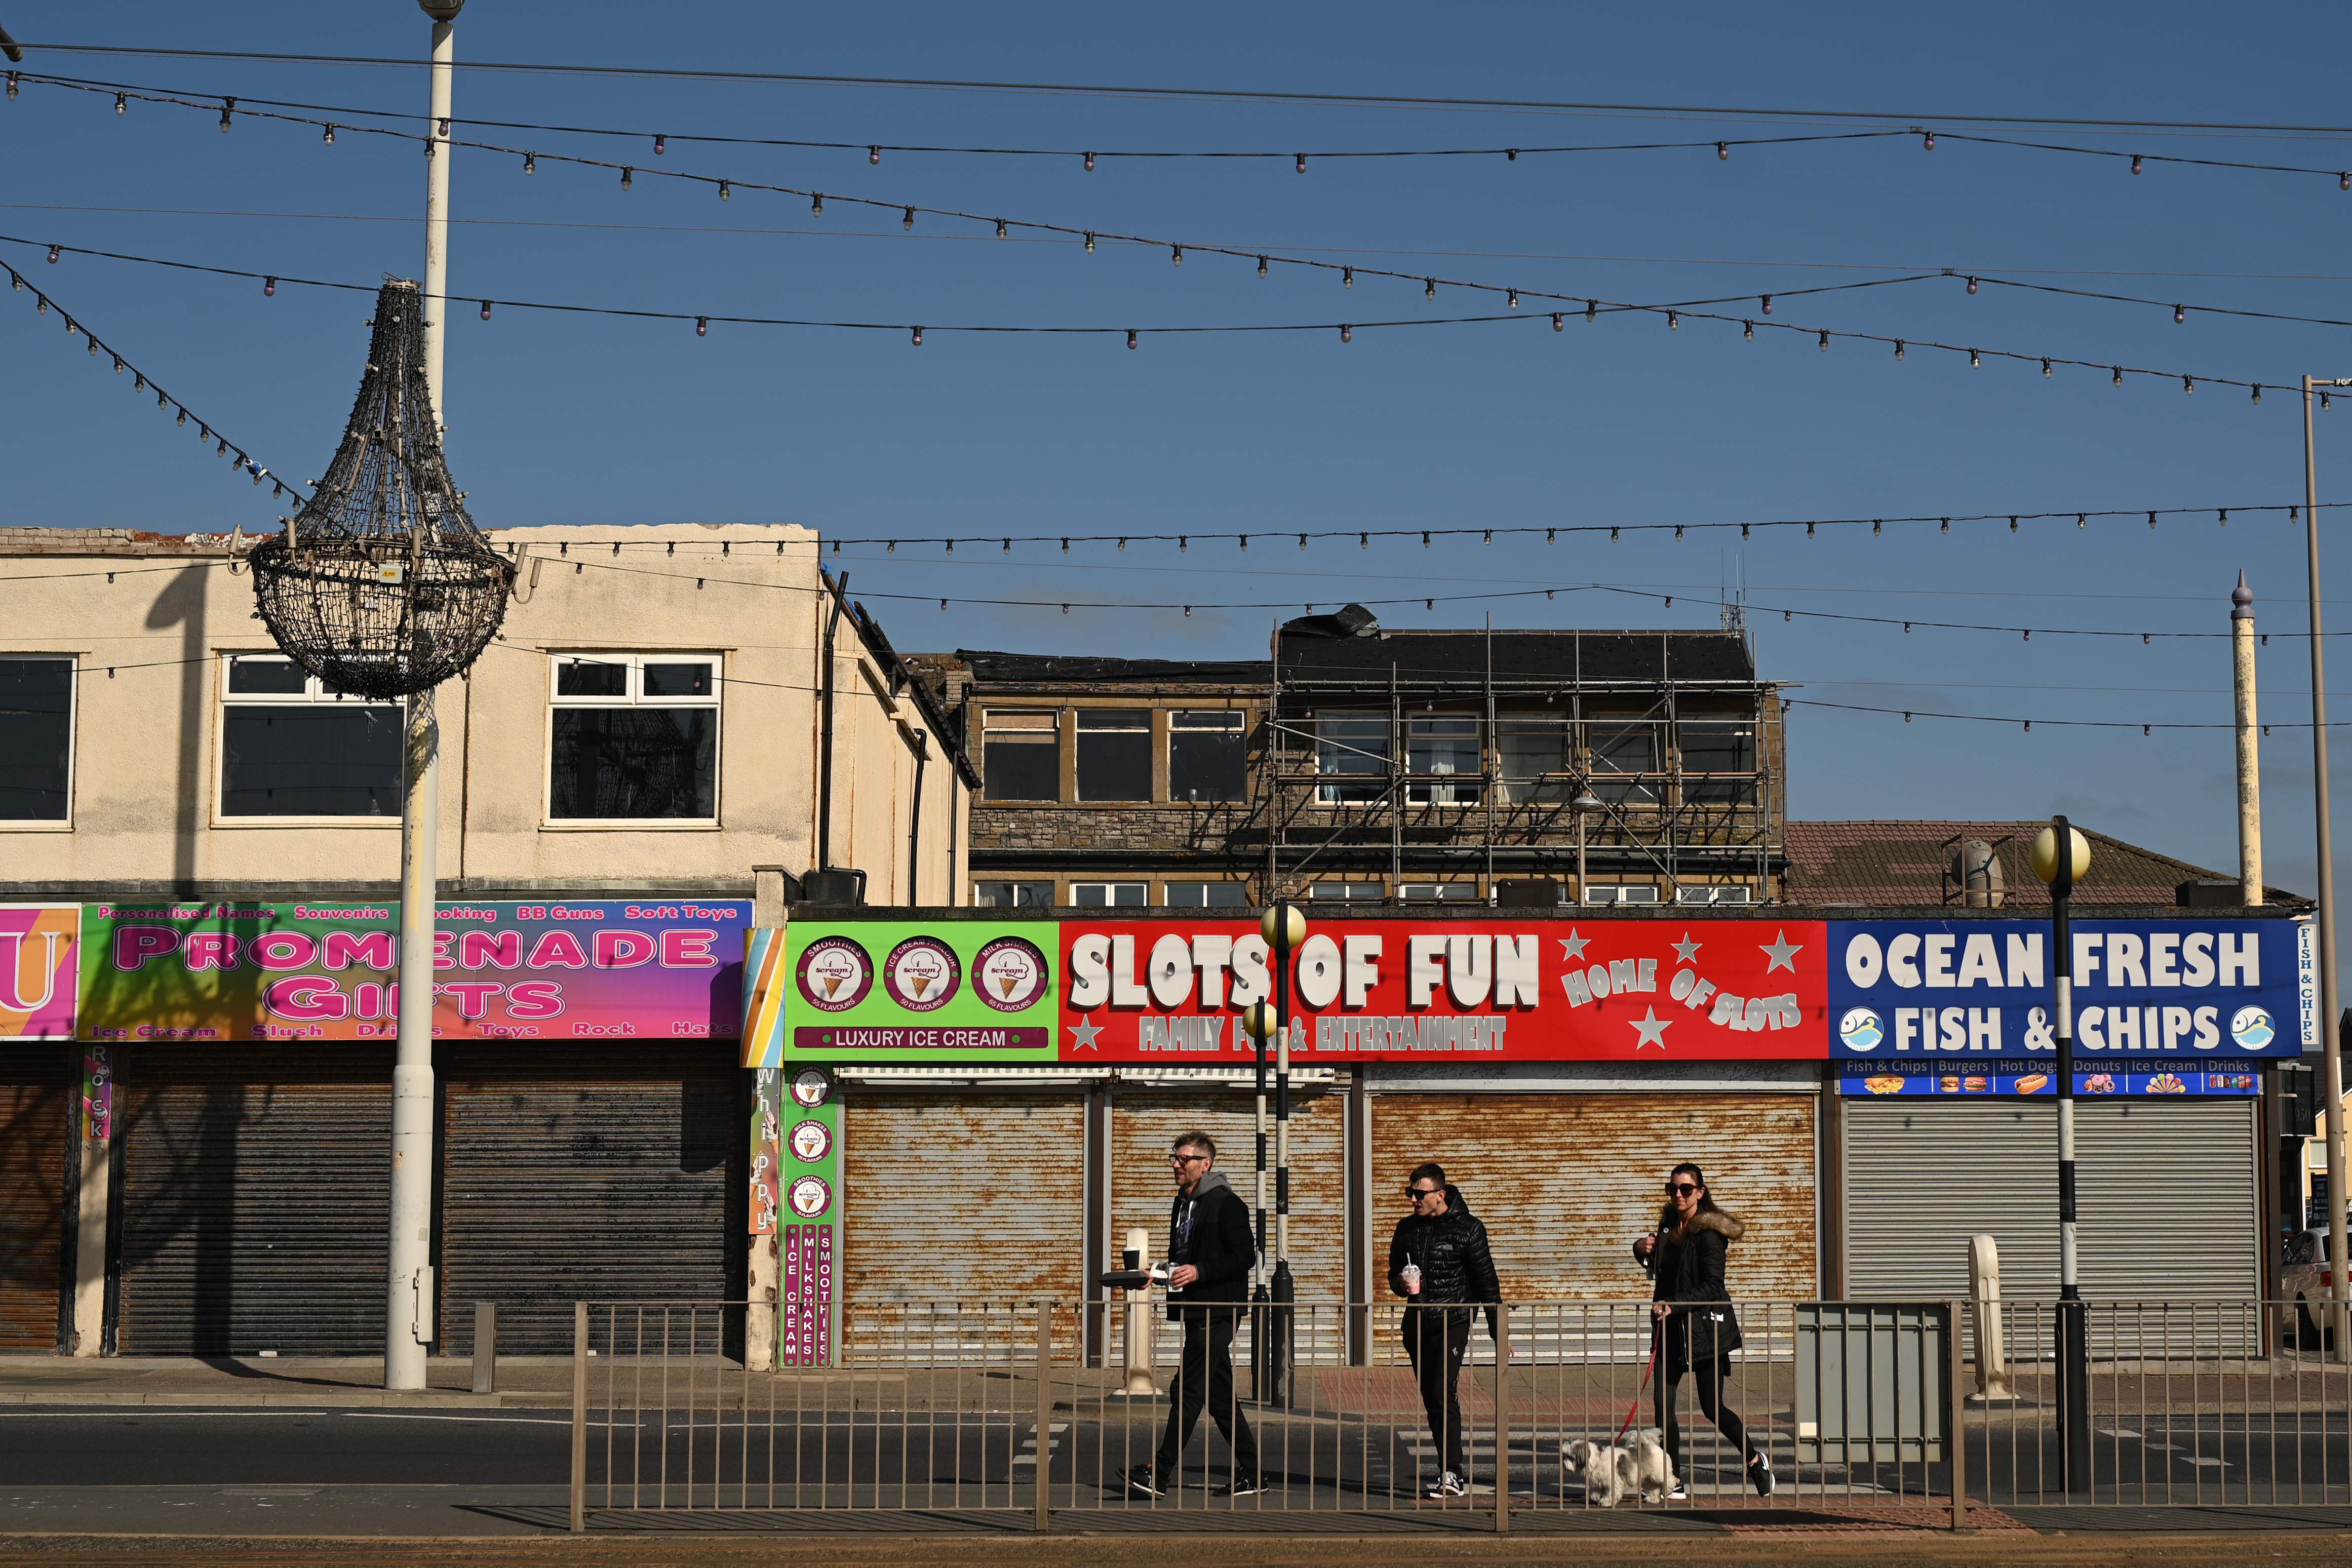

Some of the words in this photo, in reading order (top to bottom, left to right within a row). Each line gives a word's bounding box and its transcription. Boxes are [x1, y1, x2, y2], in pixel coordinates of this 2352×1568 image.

[98, 906, 211, 919] Personalised
[216, 906, 274, 919] Names
[294, 906, 388, 920] Souvenirs
[434, 906, 497, 922] oking
[517, 906, 546, 920] BB
[551, 906, 604, 920] Guns
[624, 906, 678, 919] Soft
[681, 905, 737, 921] Toys
[807, 939, 863, 957] SMOOTHIES
[888, 953, 899, 967] ICE
[897, 938, 925, 954] CREAM
[927, 939, 957, 967] PARLOUR
[982, 942, 1003, 958] MILK
[1004, 939, 1039, 959] SHAKES
[2300, 928, 2312, 969] FISH
[1845, 932, 2044, 988] OCEAN
[2073, 932, 2260, 988] FRESH
[1069, 933, 1272, 1009] SLOTS
[1296, 933, 1383, 1008] OF
[1408, 934, 1539, 1008] FUN
[2301, 974, 2312, 984] &
[1560, 957, 1658, 1008] HOME
[1670, 968, 1717, 1010] OF
[1708, 992, 1801, 1032] SLOTS
[812, 998, 820, 1007] 55
[820, 999, 855, 1011] FLAVOURS
[900, 998, 909, 1006] 50
[908, 998, 944, 1010] FLAVOURS
[988, 999, 997, 1007] 65
[996, 999, 1032, 1011] FLAVOURS
[2300, 989, 2313, 1041] CHIPS
[92, 1025, 129, 1038] Ice
[135, 1024, 218, 1038] Cream
[251, 1024, 324, 1038] Slush
[357, 1024, 443, 1037] Dris
[477, 1023, 539, 1037] Toys
[572, 1022, 636, 1036] Rock
[672, 1021, 733, 1035] Hats
[1139, 1015, 1226, 1052] FAMILY
[1289, 1015, 1309, 1051] &
[1316, 1015, 1506, 1051] ENTERTAINMENT
[1895, 1007, 2002, 1051] FISH
[2024, 1006, 2057, 1050] &
[2077, 1006, 2220, 1050] CHIPS
[836, 1030, 904, 1046] LUXURY
[910, 1030, 938, 1046] ICE
[942, 1030, 1006, 1046] CREAM
[1847, 1060, 1872, 1072] Fish
[1876, 1060, 1887, 1072] &
[1891, 1060, 1928, 1074] Chips
[1939, 1060, 1989, 1074] Burgers
[2000, 1060, 2024, 1072] Hot
[2074, 1060, 2121, 1072] Donuts
[2132, 1060, 2150, 1072] Ice
[2154, 1060, 2197, 1072] Cream
[2208, 1059, 2250, 1072] Drinks
[797, 1066, 813, 1075] CREAM
[814, 1066, 831, 1083] PARLOUR
[794, 1122, 806, 1132] MILK
[806, 1120, 827, 1132] SHAKES
[757, 1068, 774, 1230] Whippy
[794, 1175, 826, 1187] SMOOTHIES
[788, 1239, 797, 1275] ICE
[803, 1238, 815, 1355] MILKSHAKES
[819, 1237, 830, 1355] SMOOTHIES
[786, 1291, 797, 1355] CREAM
